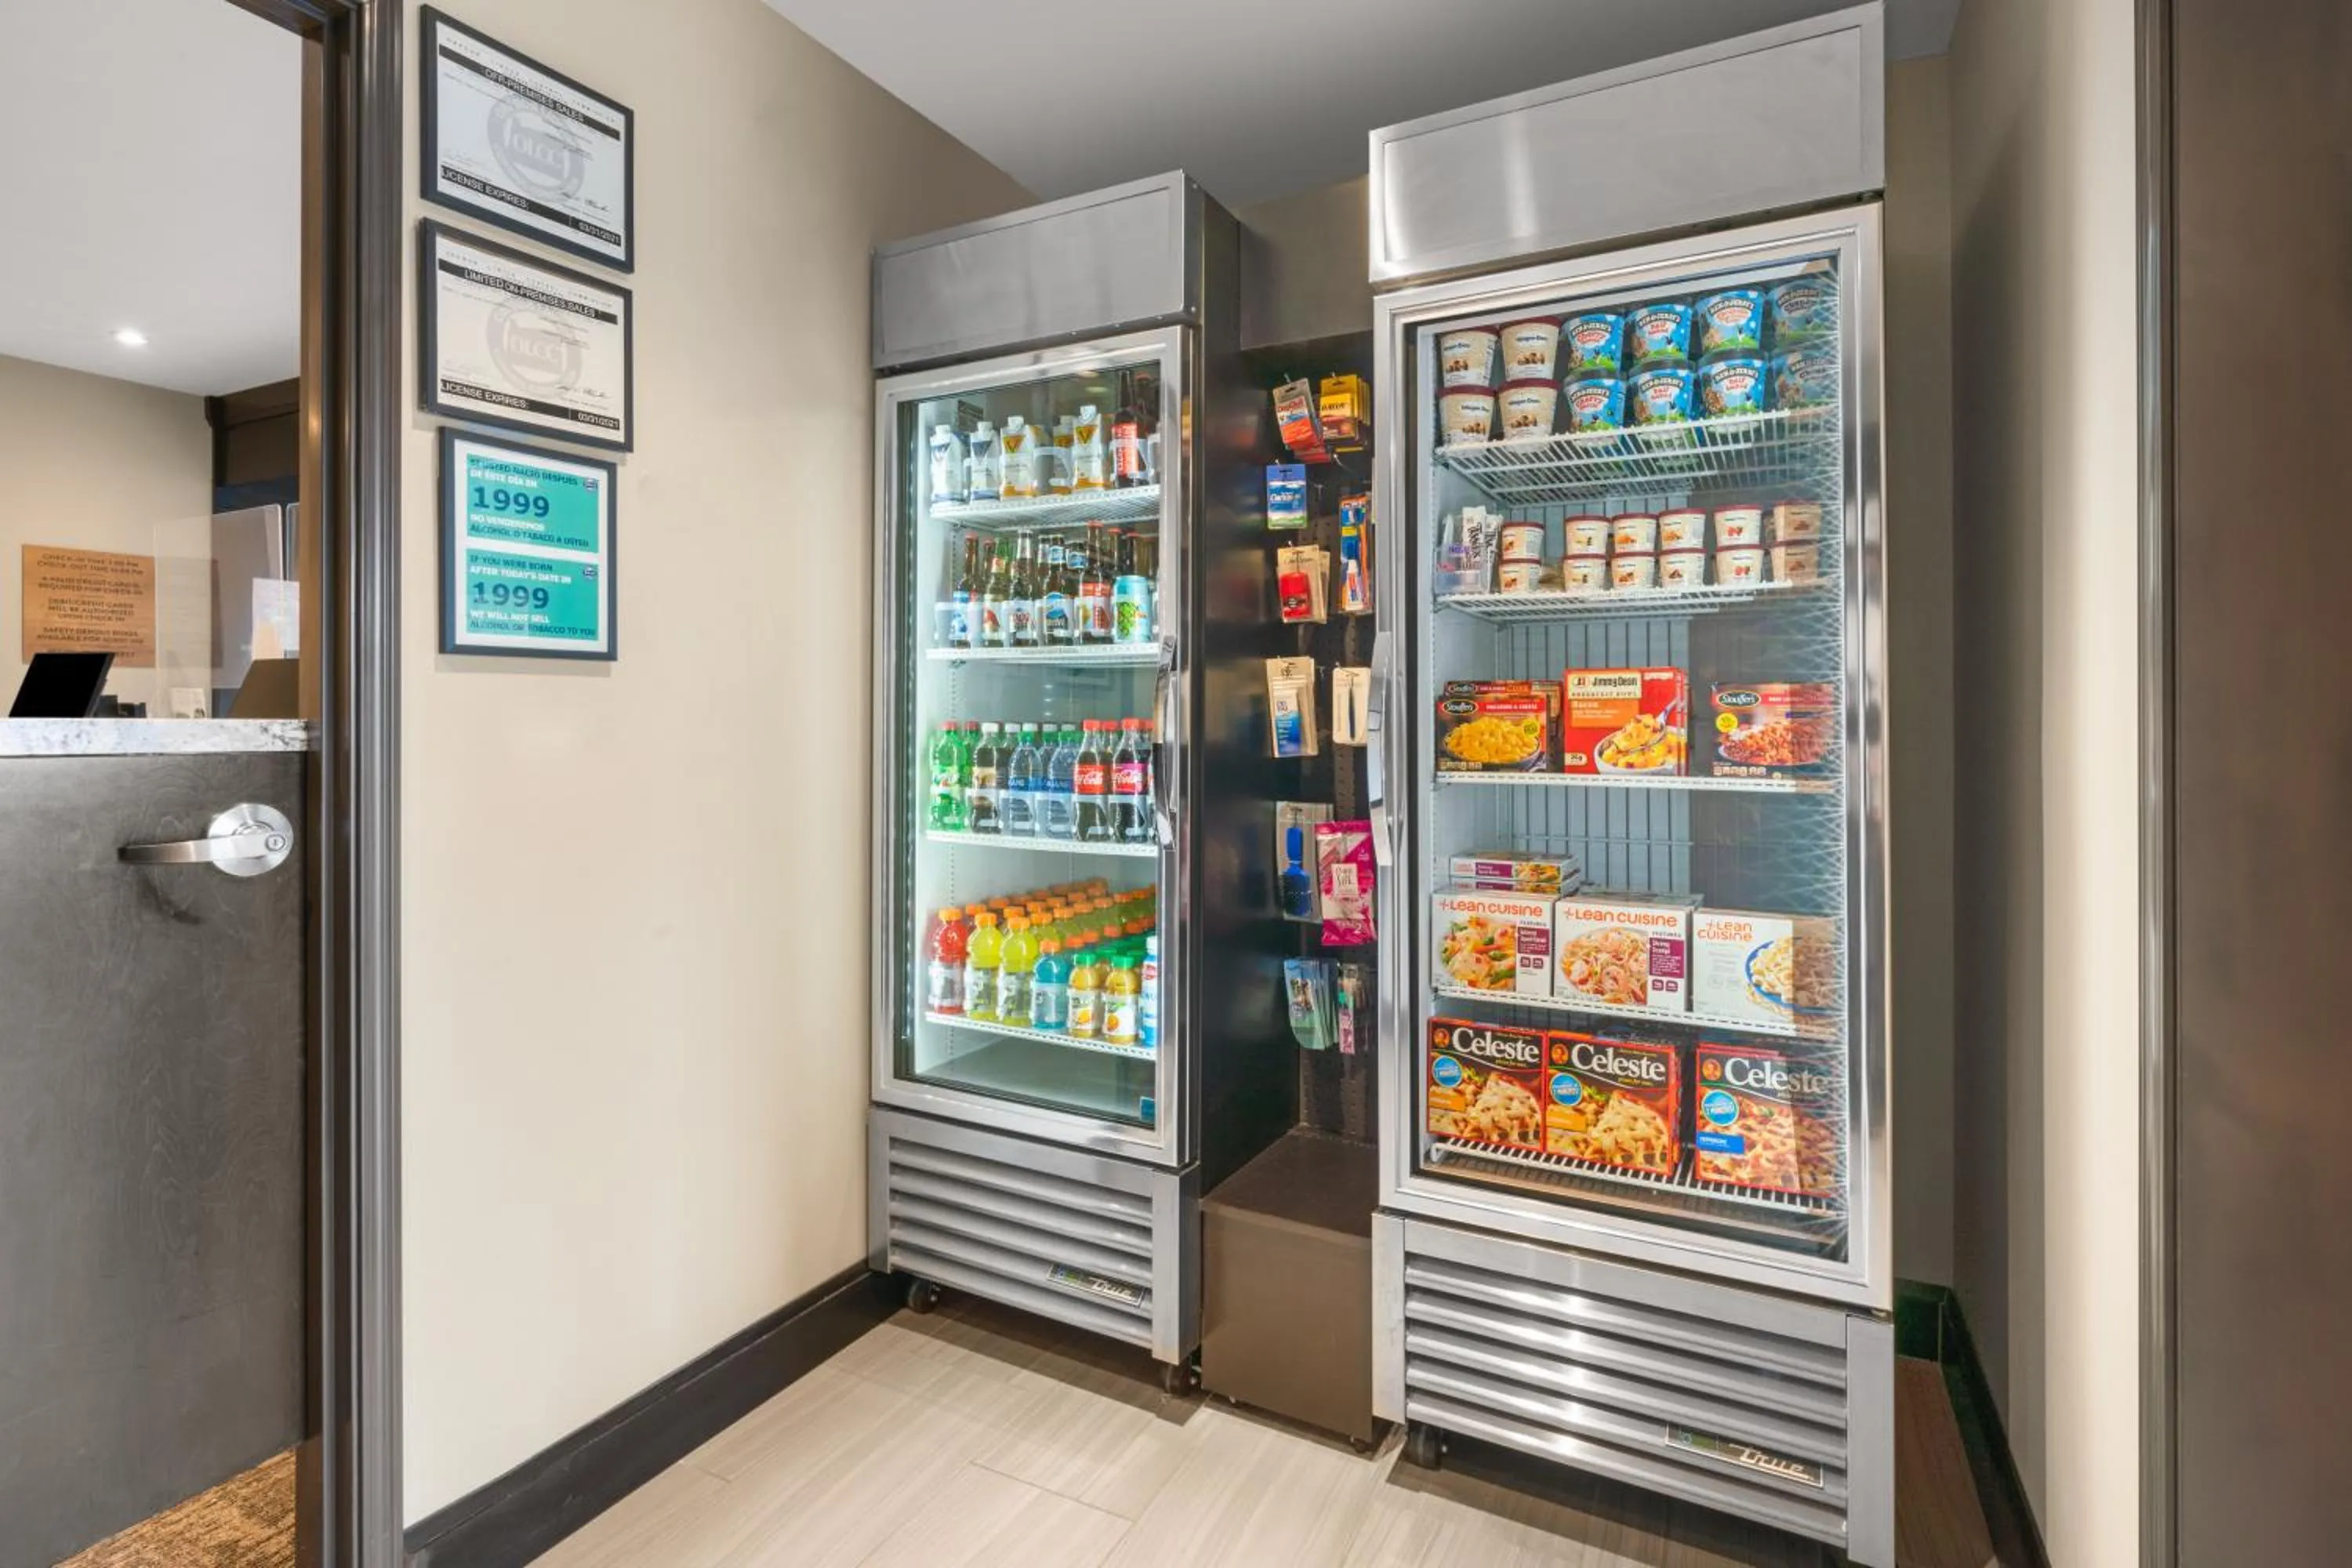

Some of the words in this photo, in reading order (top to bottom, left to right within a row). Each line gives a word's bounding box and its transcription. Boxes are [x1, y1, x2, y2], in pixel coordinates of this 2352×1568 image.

[555, 100, 586, 122] SALES
[442, 168, 484, 192] LICENSE
[464, 268, 503, 288] LIMITED
[568, 301, 596, 318] SALES
[441, 383, 484, 399] LICENSE
[473, 486, 550, 517] 1999
[482, 556, 500, 565] YOU
[503, 559, 527, 569] WERE
[529, 562, 553, 572] BORN
[472, 581, 550, 609] 1999
[1592, 677, 1617, 687] Jimmy
[1617, 676, 1638, 686] Dean
[1452, 1027, 1540, 1063] Celeste
[1571, 1044, 1666, 1081] Celeste
[1725, 1057, 1828, 1094] Celeste
